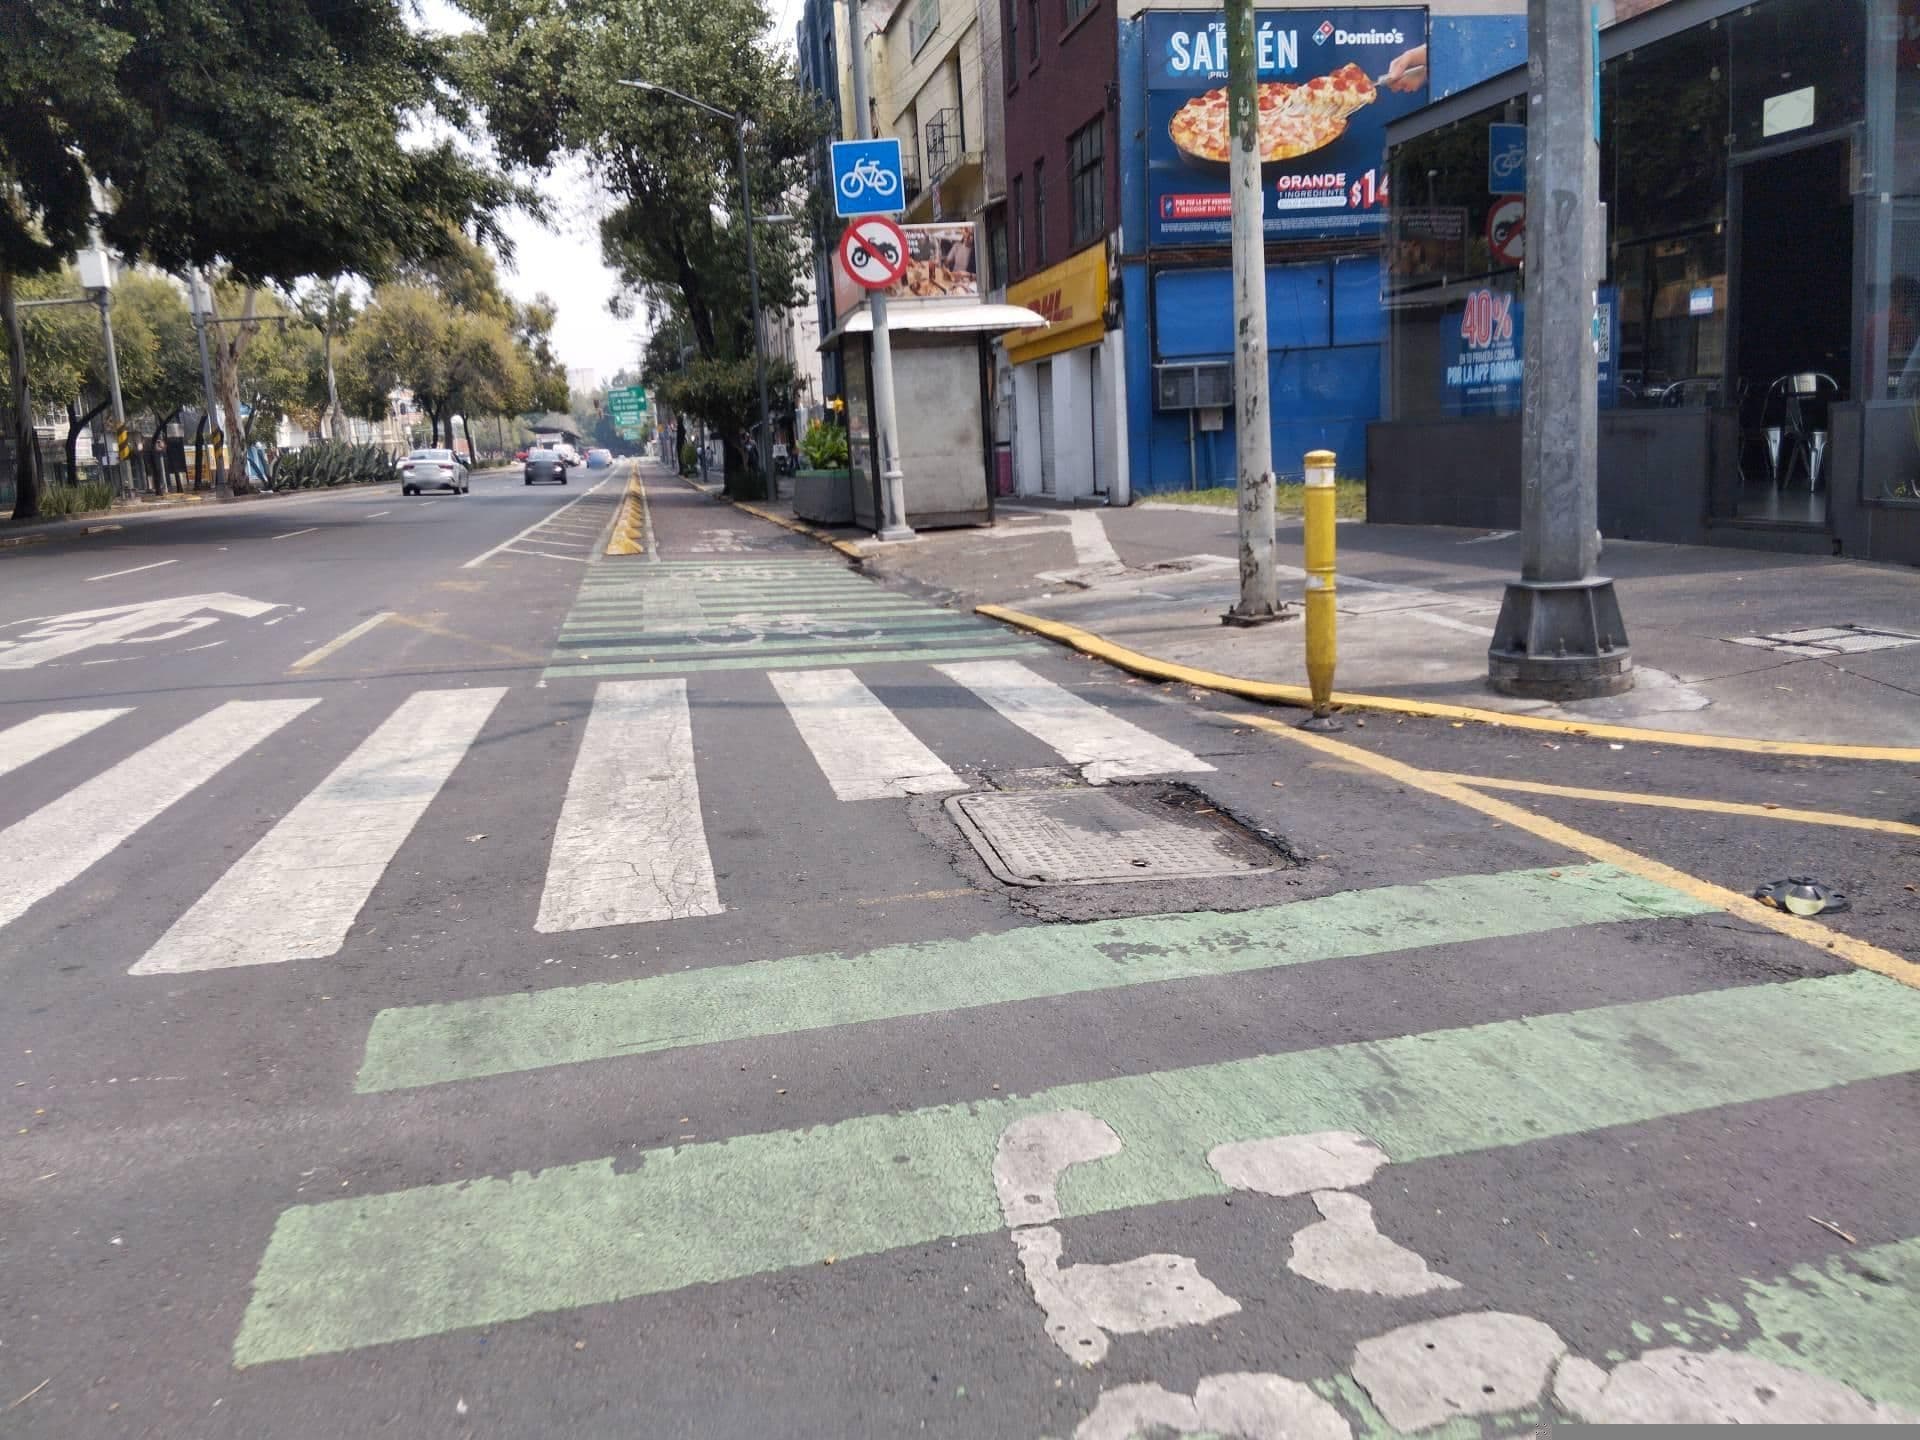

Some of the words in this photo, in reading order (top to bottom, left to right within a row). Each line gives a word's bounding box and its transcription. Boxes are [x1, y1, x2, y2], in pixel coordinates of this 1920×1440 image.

[1208, 22, 1226, 32] PIZ
[1335, 28, 1404, 45] Domino's
[1170, 21, 1298, 71] SARÉN
[1208, 71, 1228, 80] ¡PRU
[1279, 172, 1347, 190] GRANDE
[1284, 188, 1345, 198] INGREDIENTE
[1461, 289, 1513, 349] 40%
[1447, 366, 1462, 385] POR
[1463, 364, 1473, 383] LA
[1473, 362, 1490, 383] APP
[1490, 359, 1525, 382] DOMINO
